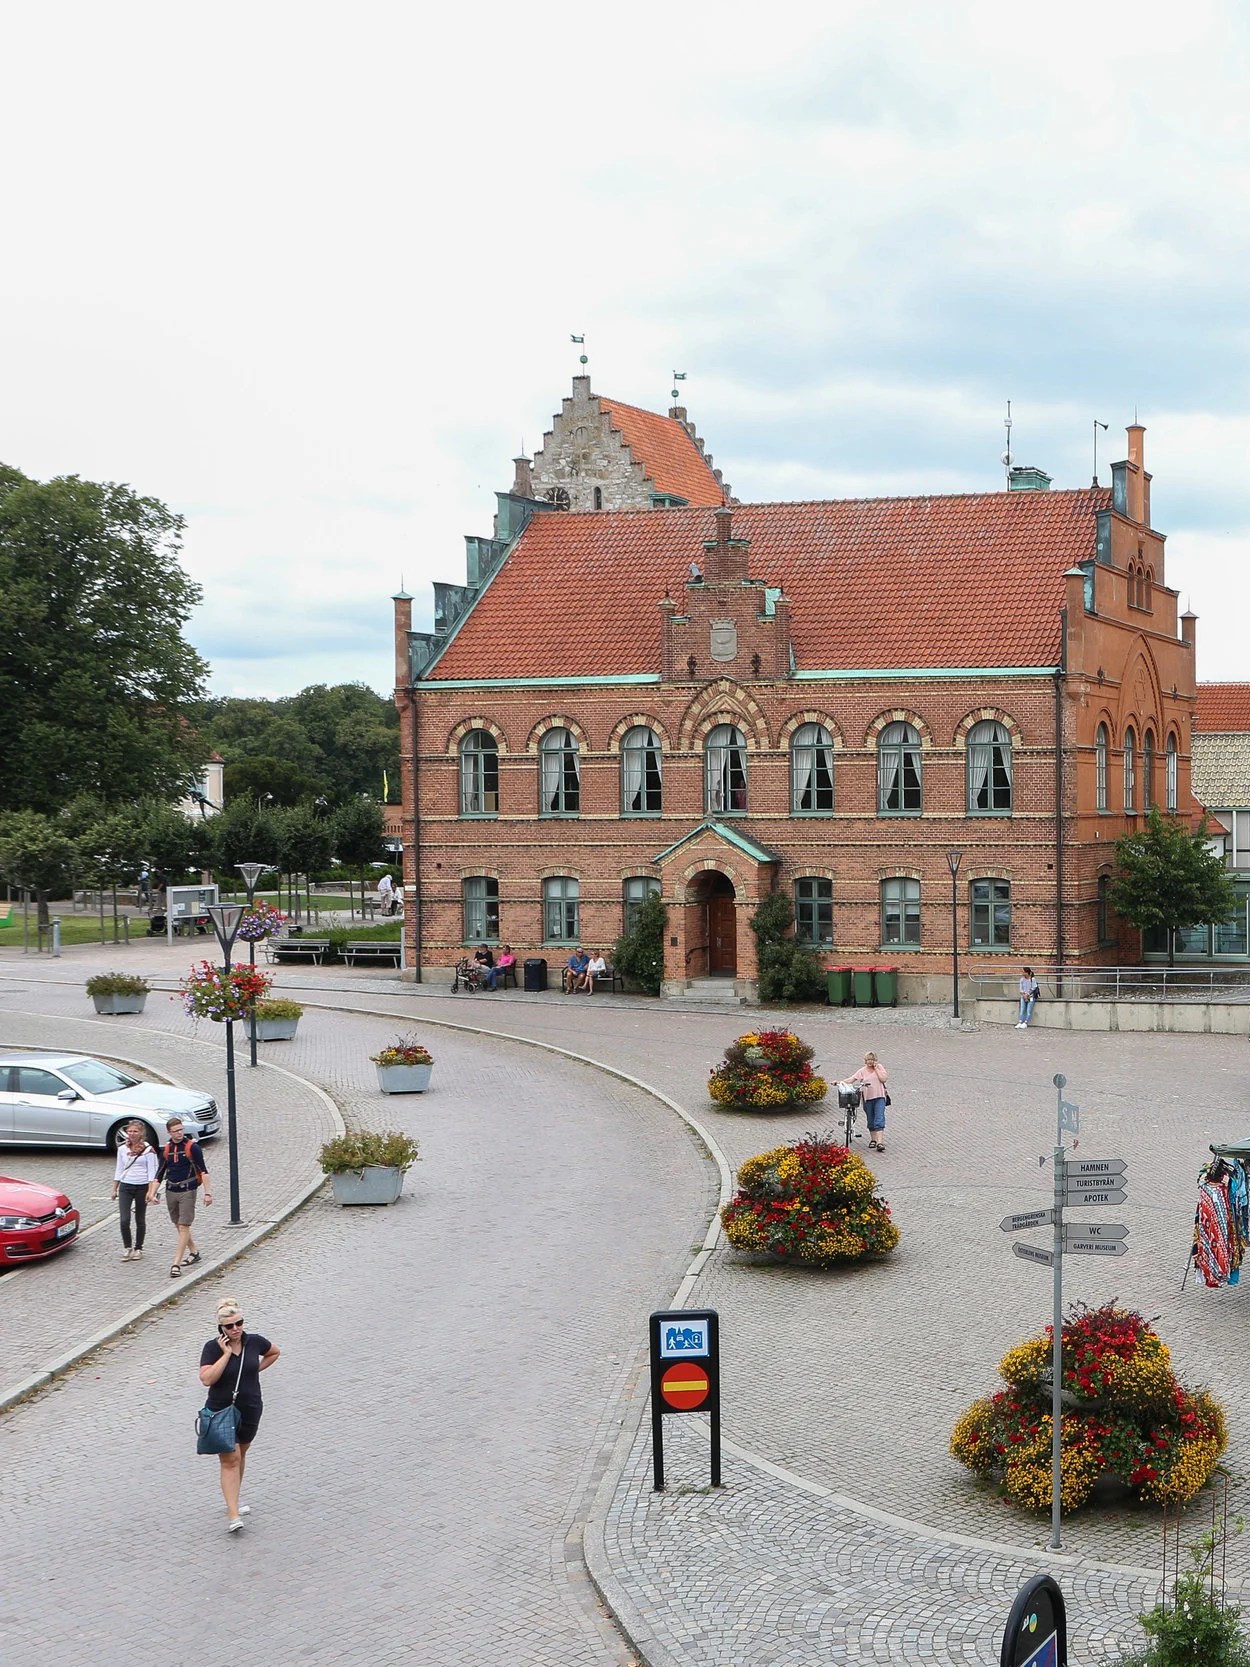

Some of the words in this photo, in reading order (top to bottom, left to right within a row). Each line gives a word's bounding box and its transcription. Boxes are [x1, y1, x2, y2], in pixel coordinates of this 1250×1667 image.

[1080, 1164, 1109, 1172] HAMNEN
[1076, 1178, 1114, 1187] TURISTBYRÅN
[1084, 1194, 1109, 1203] APOTEK
[1089, 1227, 1101, 1235] WC
